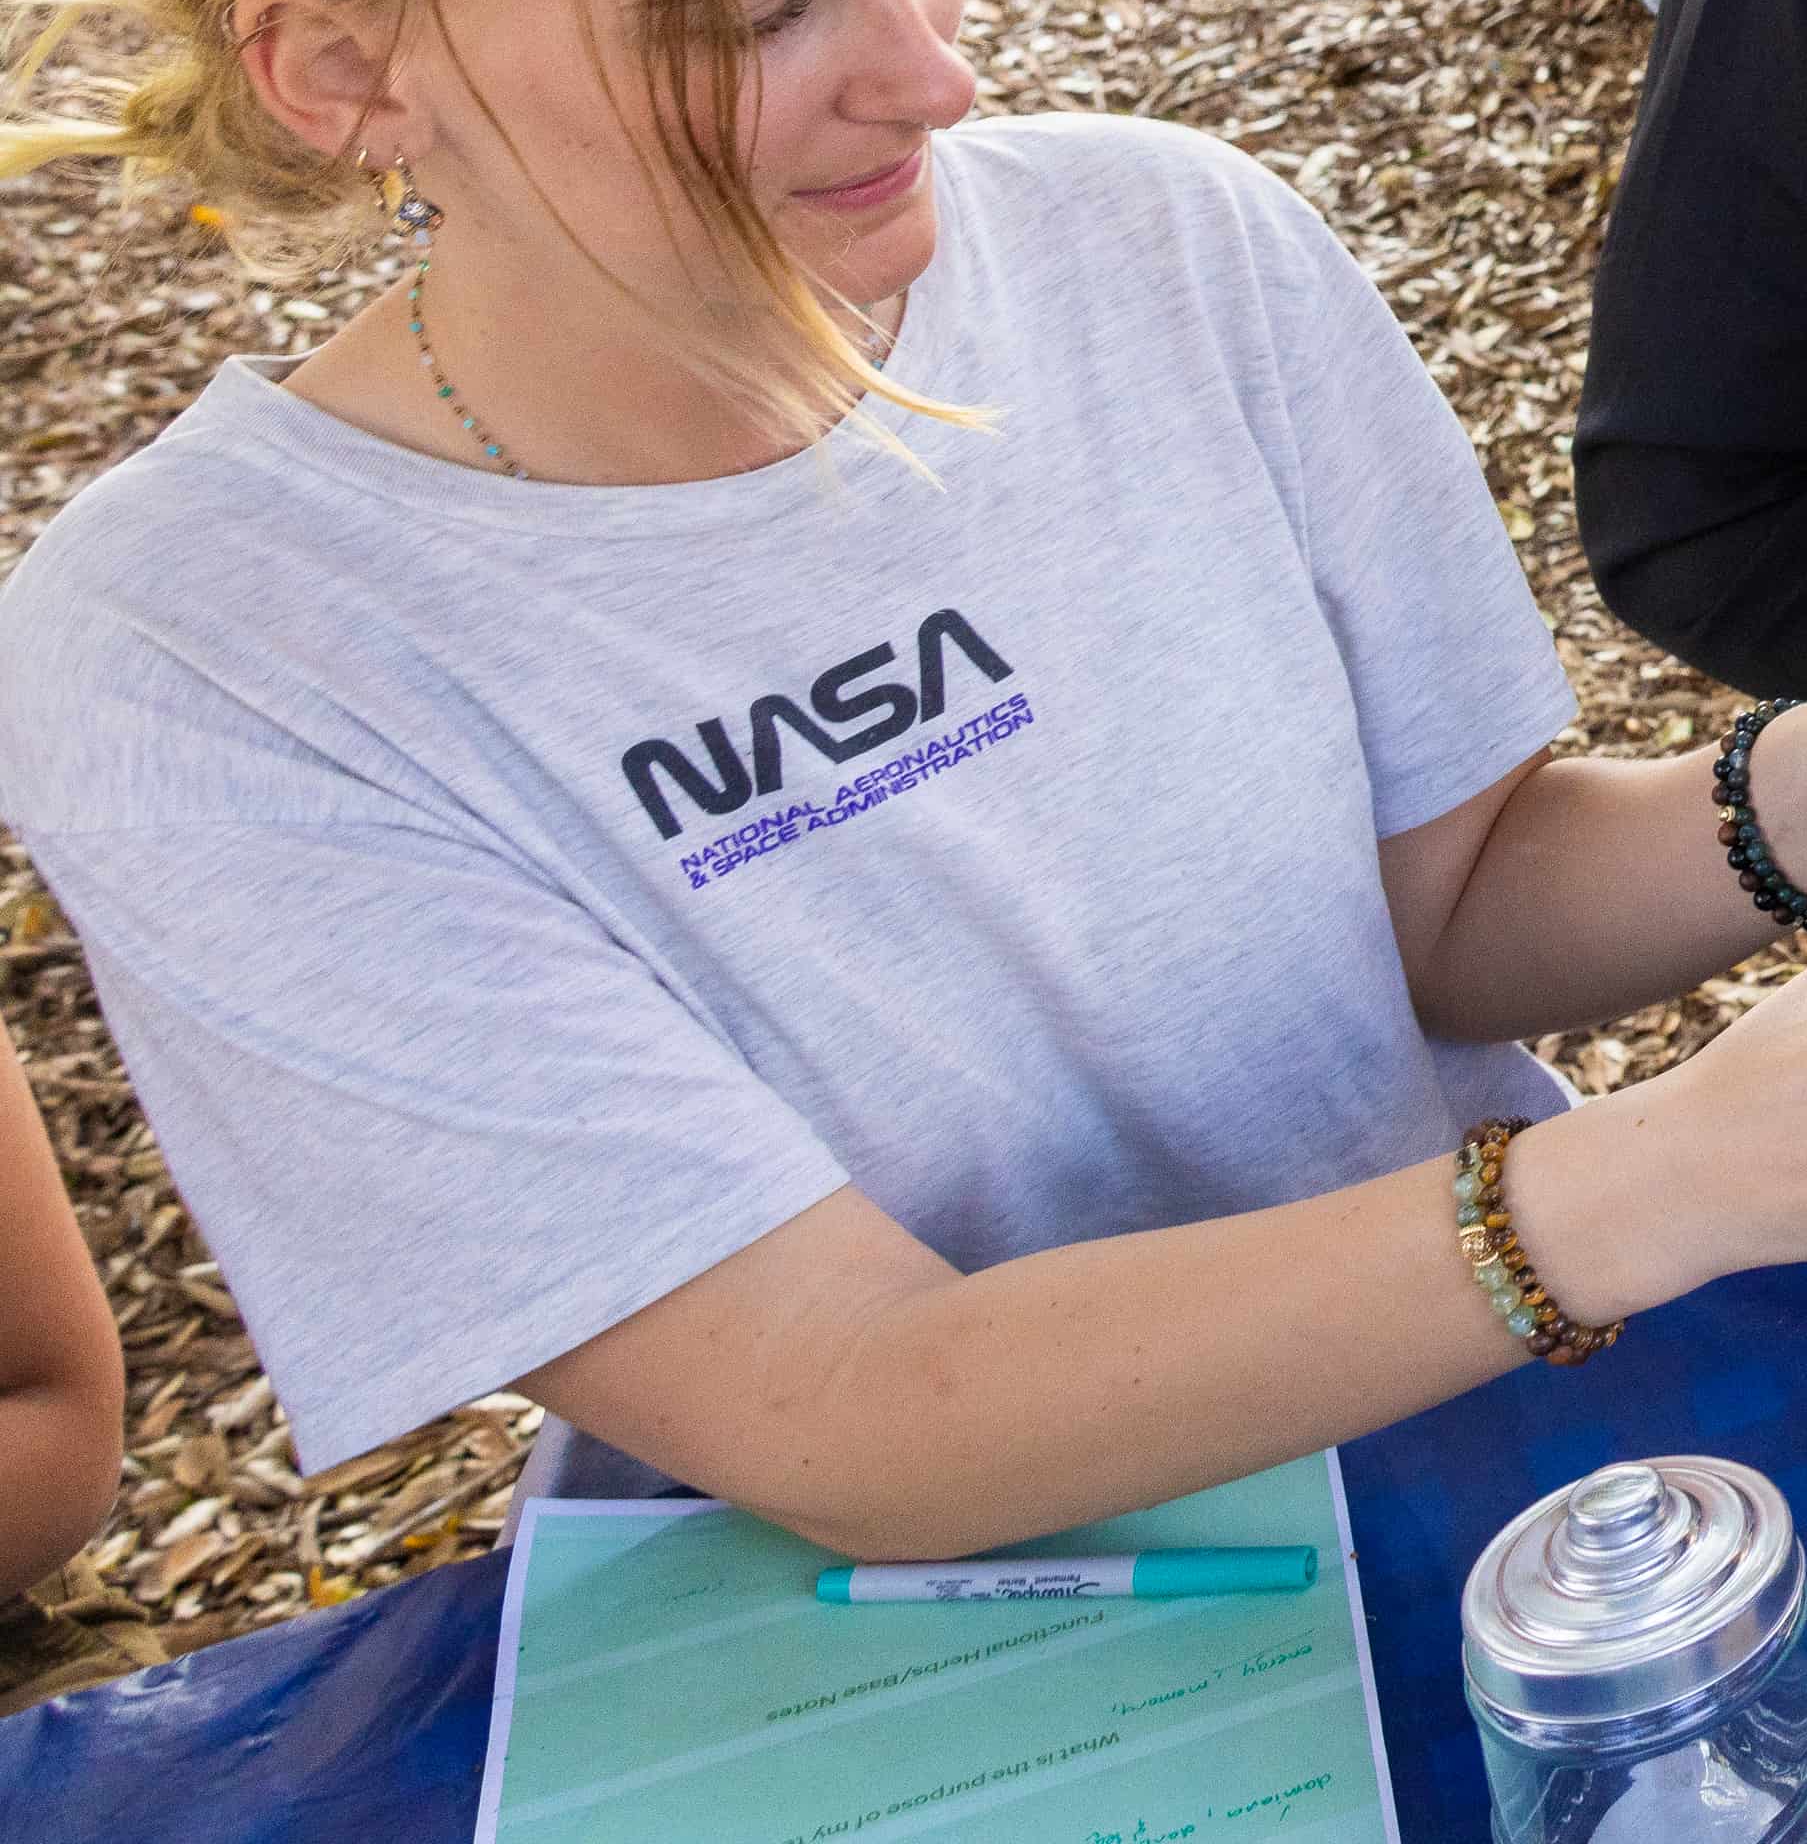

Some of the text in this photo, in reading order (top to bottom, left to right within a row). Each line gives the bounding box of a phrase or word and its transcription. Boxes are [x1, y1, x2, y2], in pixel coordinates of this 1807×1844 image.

[621, 609, 1014, 840] NASA
[680, 693, 1027, 873] NATIONAL AERONAUTICS
[689, 709, 1034, 890] & SPACE ADMINISTRATION
[997, 1574, 1080, 1586] Permanent Marker
[763, 1608, 1106, 1726] Functional Herbs/Base Notes
[809, 1729, 1121, 1844] What is the purpose of my
